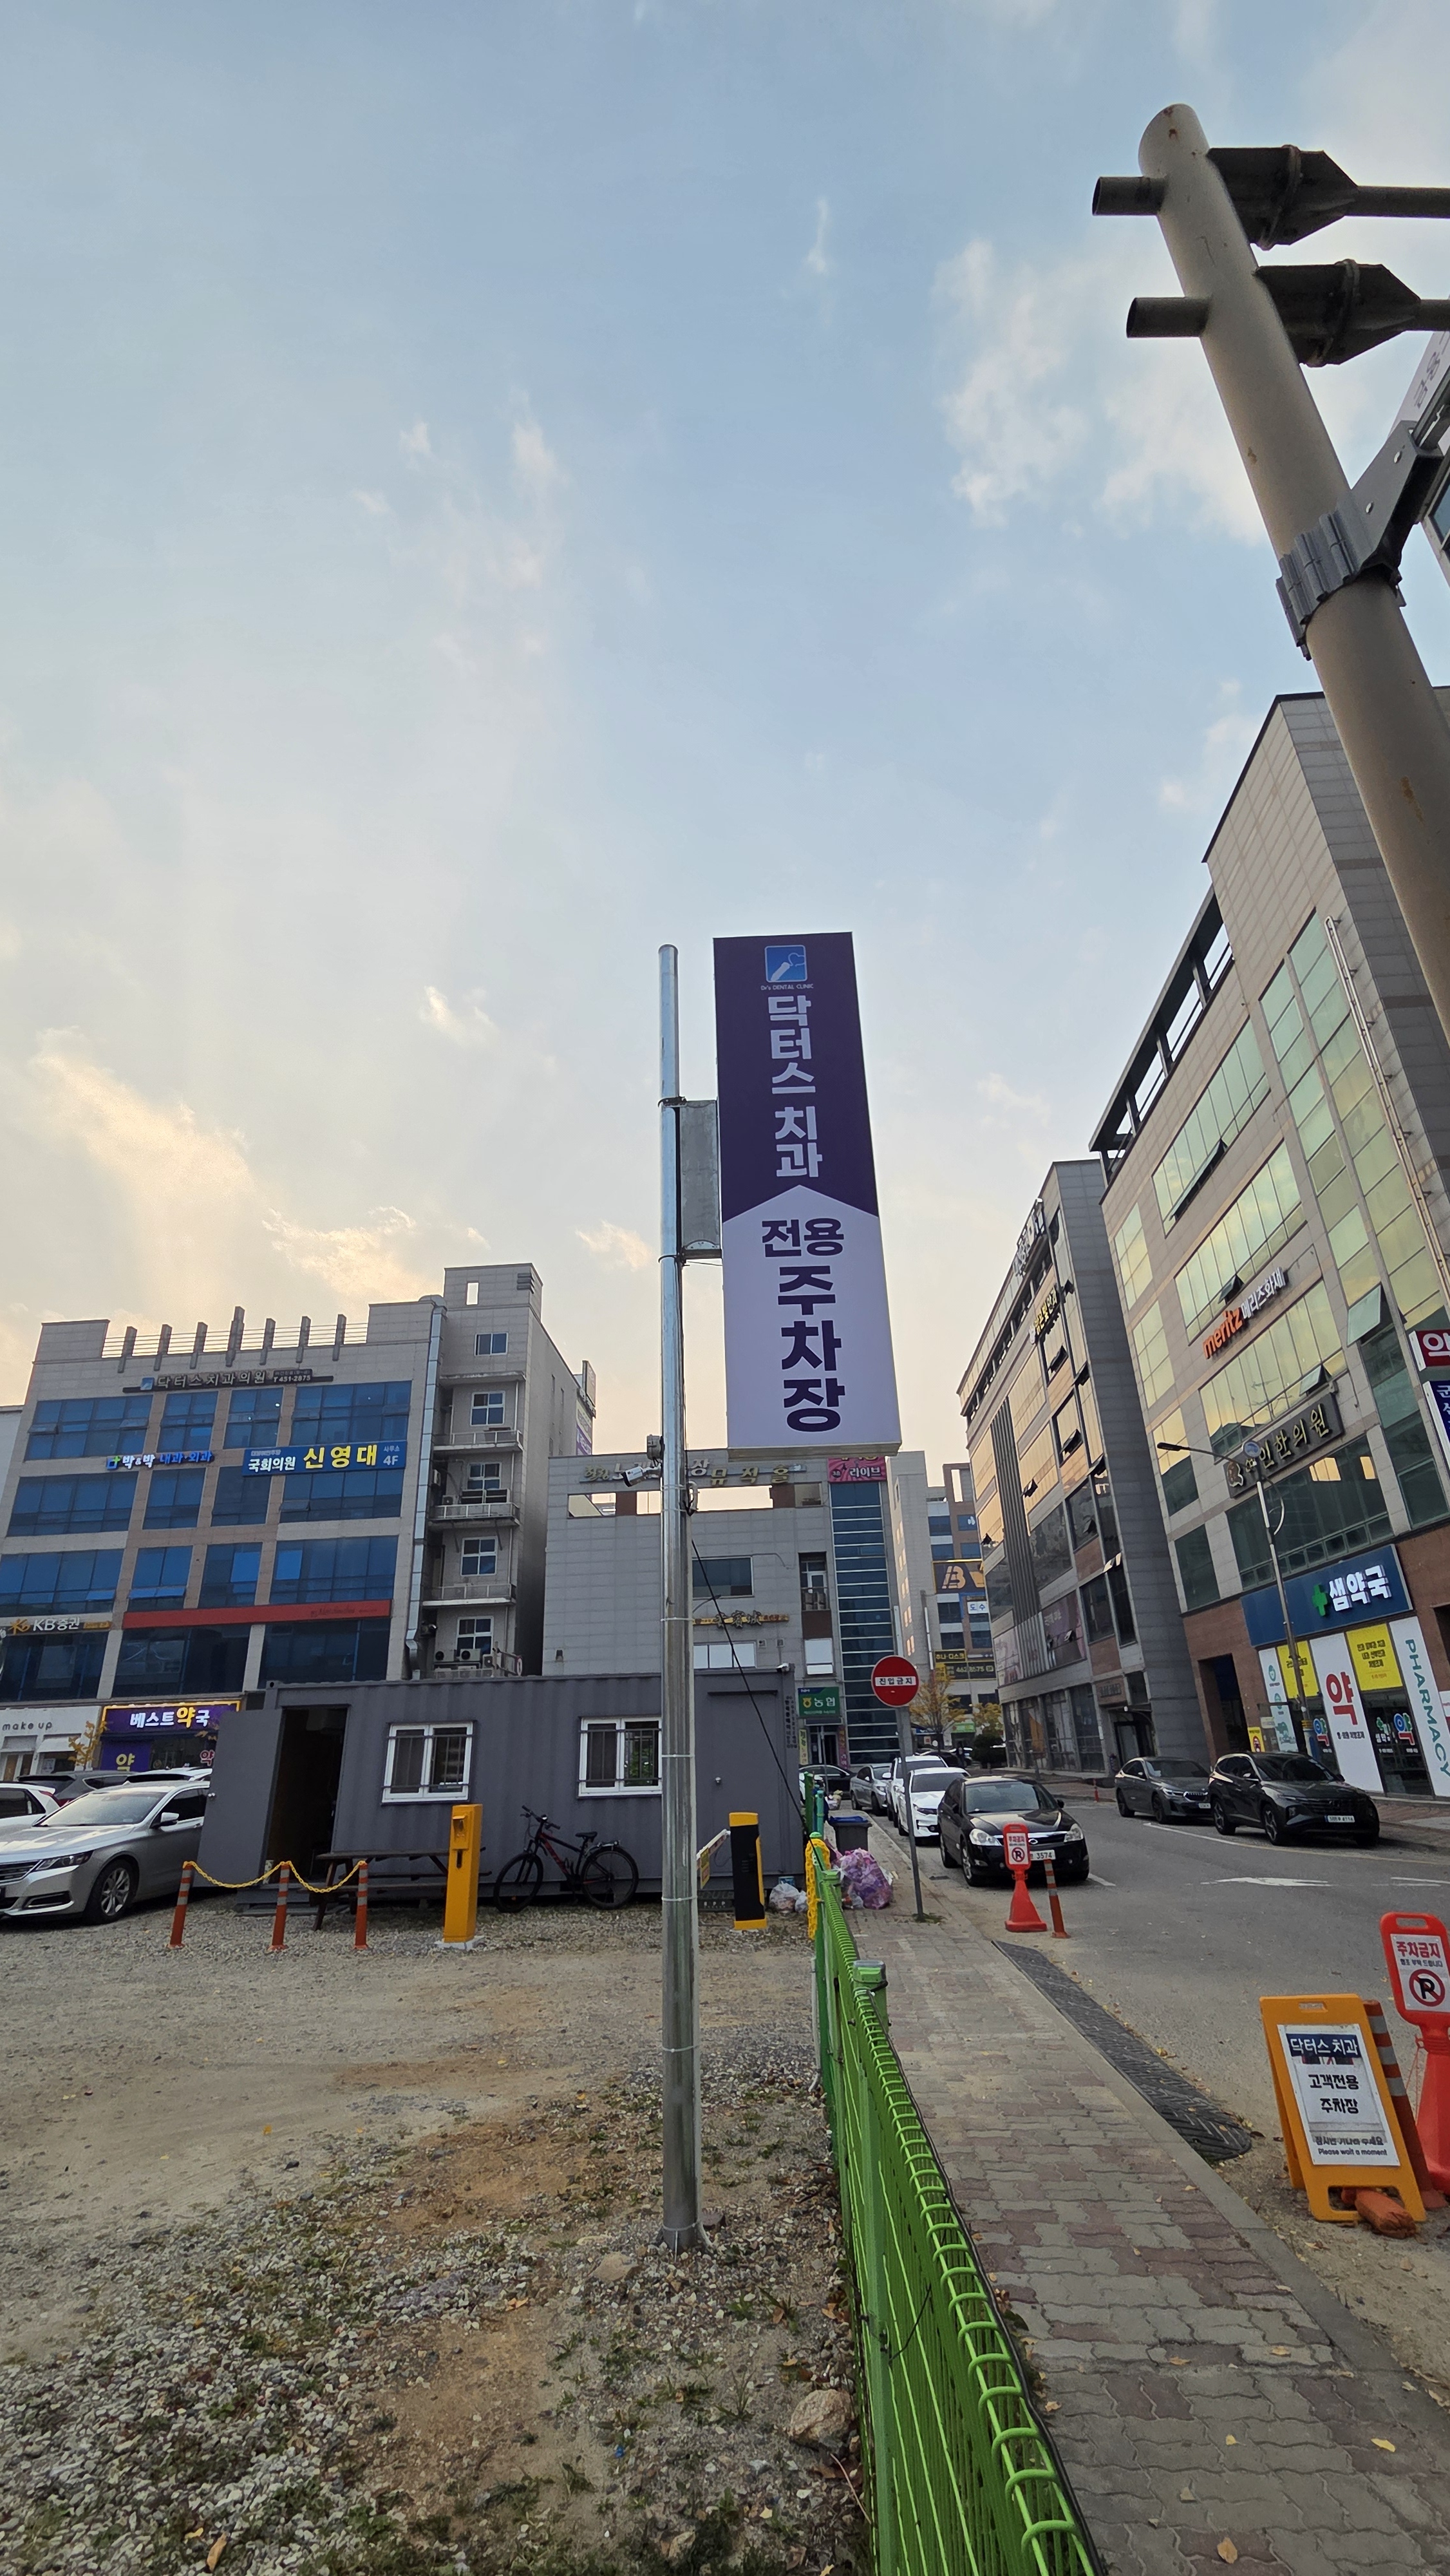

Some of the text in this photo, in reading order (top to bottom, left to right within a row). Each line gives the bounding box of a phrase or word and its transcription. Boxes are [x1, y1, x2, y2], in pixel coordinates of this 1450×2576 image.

[767, 995, 823, 1178] 닥터스 치과
[761, 1217, 844, 1257] 전용
[1203, 1267, 1286, 1359] meritz 메리츠화재
[777, 1265, 846, 1433] 주차장
[156, 1370, 267, 1388] 닥터스치과의원
[122, 1454, 155, 1469] 박&박
[248, 1444, 377, 1472] 국회의원 신영대
[382, 1455, 399, 1466] 4F
[711, 1464, 789, 1485] 뮤직홀
[850, 1466, 881, 1477] 라이브
[1329, 1564, 1391, 1611] 샘약국
[33, 1616, 80, 1631] KB증권
[880, 1677, 912, 1685] 진입금지
[814, 1697, 836, 1707] 농협
[1326, 1671, 1358, 1725] 약
[2, 1721, 53, 1731] make up
[129, 1707, 210, 1728] 베스트약국
[116, 1753, 135, 1771] 약
[1396, 1941, 1440, 1958] 주차금지
[1290, 2038, 1358, 2056] 닥터스 치과
[1308, 2074, 1359, 2090] 고객전용
[1320, 2098, 1359, 2114] 주차장
